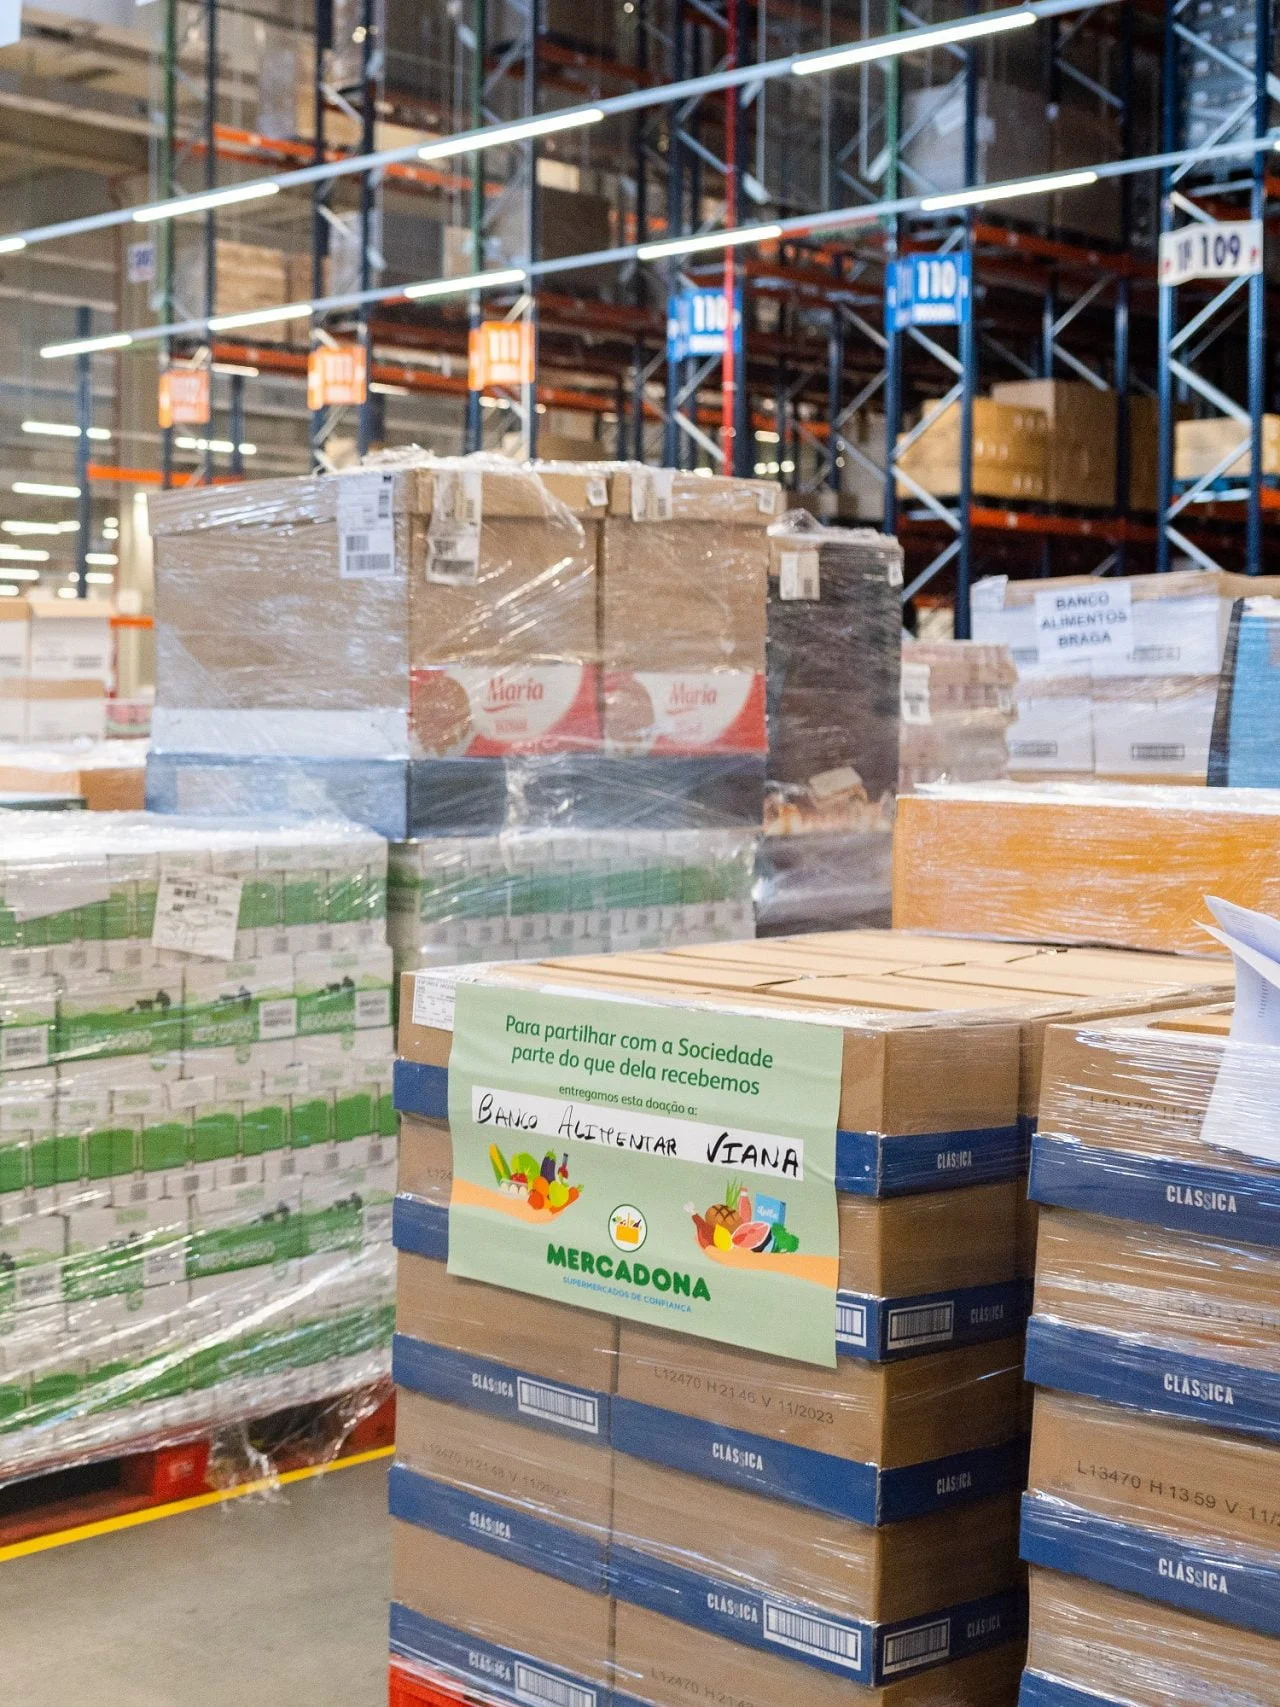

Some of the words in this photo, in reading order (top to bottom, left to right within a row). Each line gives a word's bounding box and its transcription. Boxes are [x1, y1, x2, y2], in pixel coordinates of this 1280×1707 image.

[1201, 234, 1241, 267] 109
[917, 260, 958, 300] 110
[1055, 590, 1110, 611] BANCO
[1040, 608, 1128, 631] ALIMENTOS
[1058, 631, 1112, 648] BRAGA
[506, 1015, 540, 1036] Para
[544, 1024, 616, 1046] partilhar
[620, 1035, 657, 1053] com
[661, 1040, 673, 1055] a
[678, 1038, 773, 1069] Sociedade
[511, 1046, 555, 1064] parte
[559, 1049, 579, 1068] do
[584, 1056, 615, 1075] que
[619, 1058, 656, 1080] dela
[661, 1067, 760, 1095] recebemos
[559, 1085, 619, 1103] entregamos
[621, 1095, 643, 1107] esta
[645, 1096, 685, 1114] doação
[687, 1105, 699, 1116] a:
[477, 1093, 538, 1130] BANCO
[558, 1105, 677, 1157] ALIMENTAR
[706, 1131, 799, 1178] VIANA
[546, 1243, 712, 1302] MERCADONA
[562, 1275, 629, 1300] SUPERMERCADOS
[631, 1292, 641, 1302] DE
[778, 1400, 835, 1425] 11/2023
[1077, 1459, 1141, 1489] L13470
